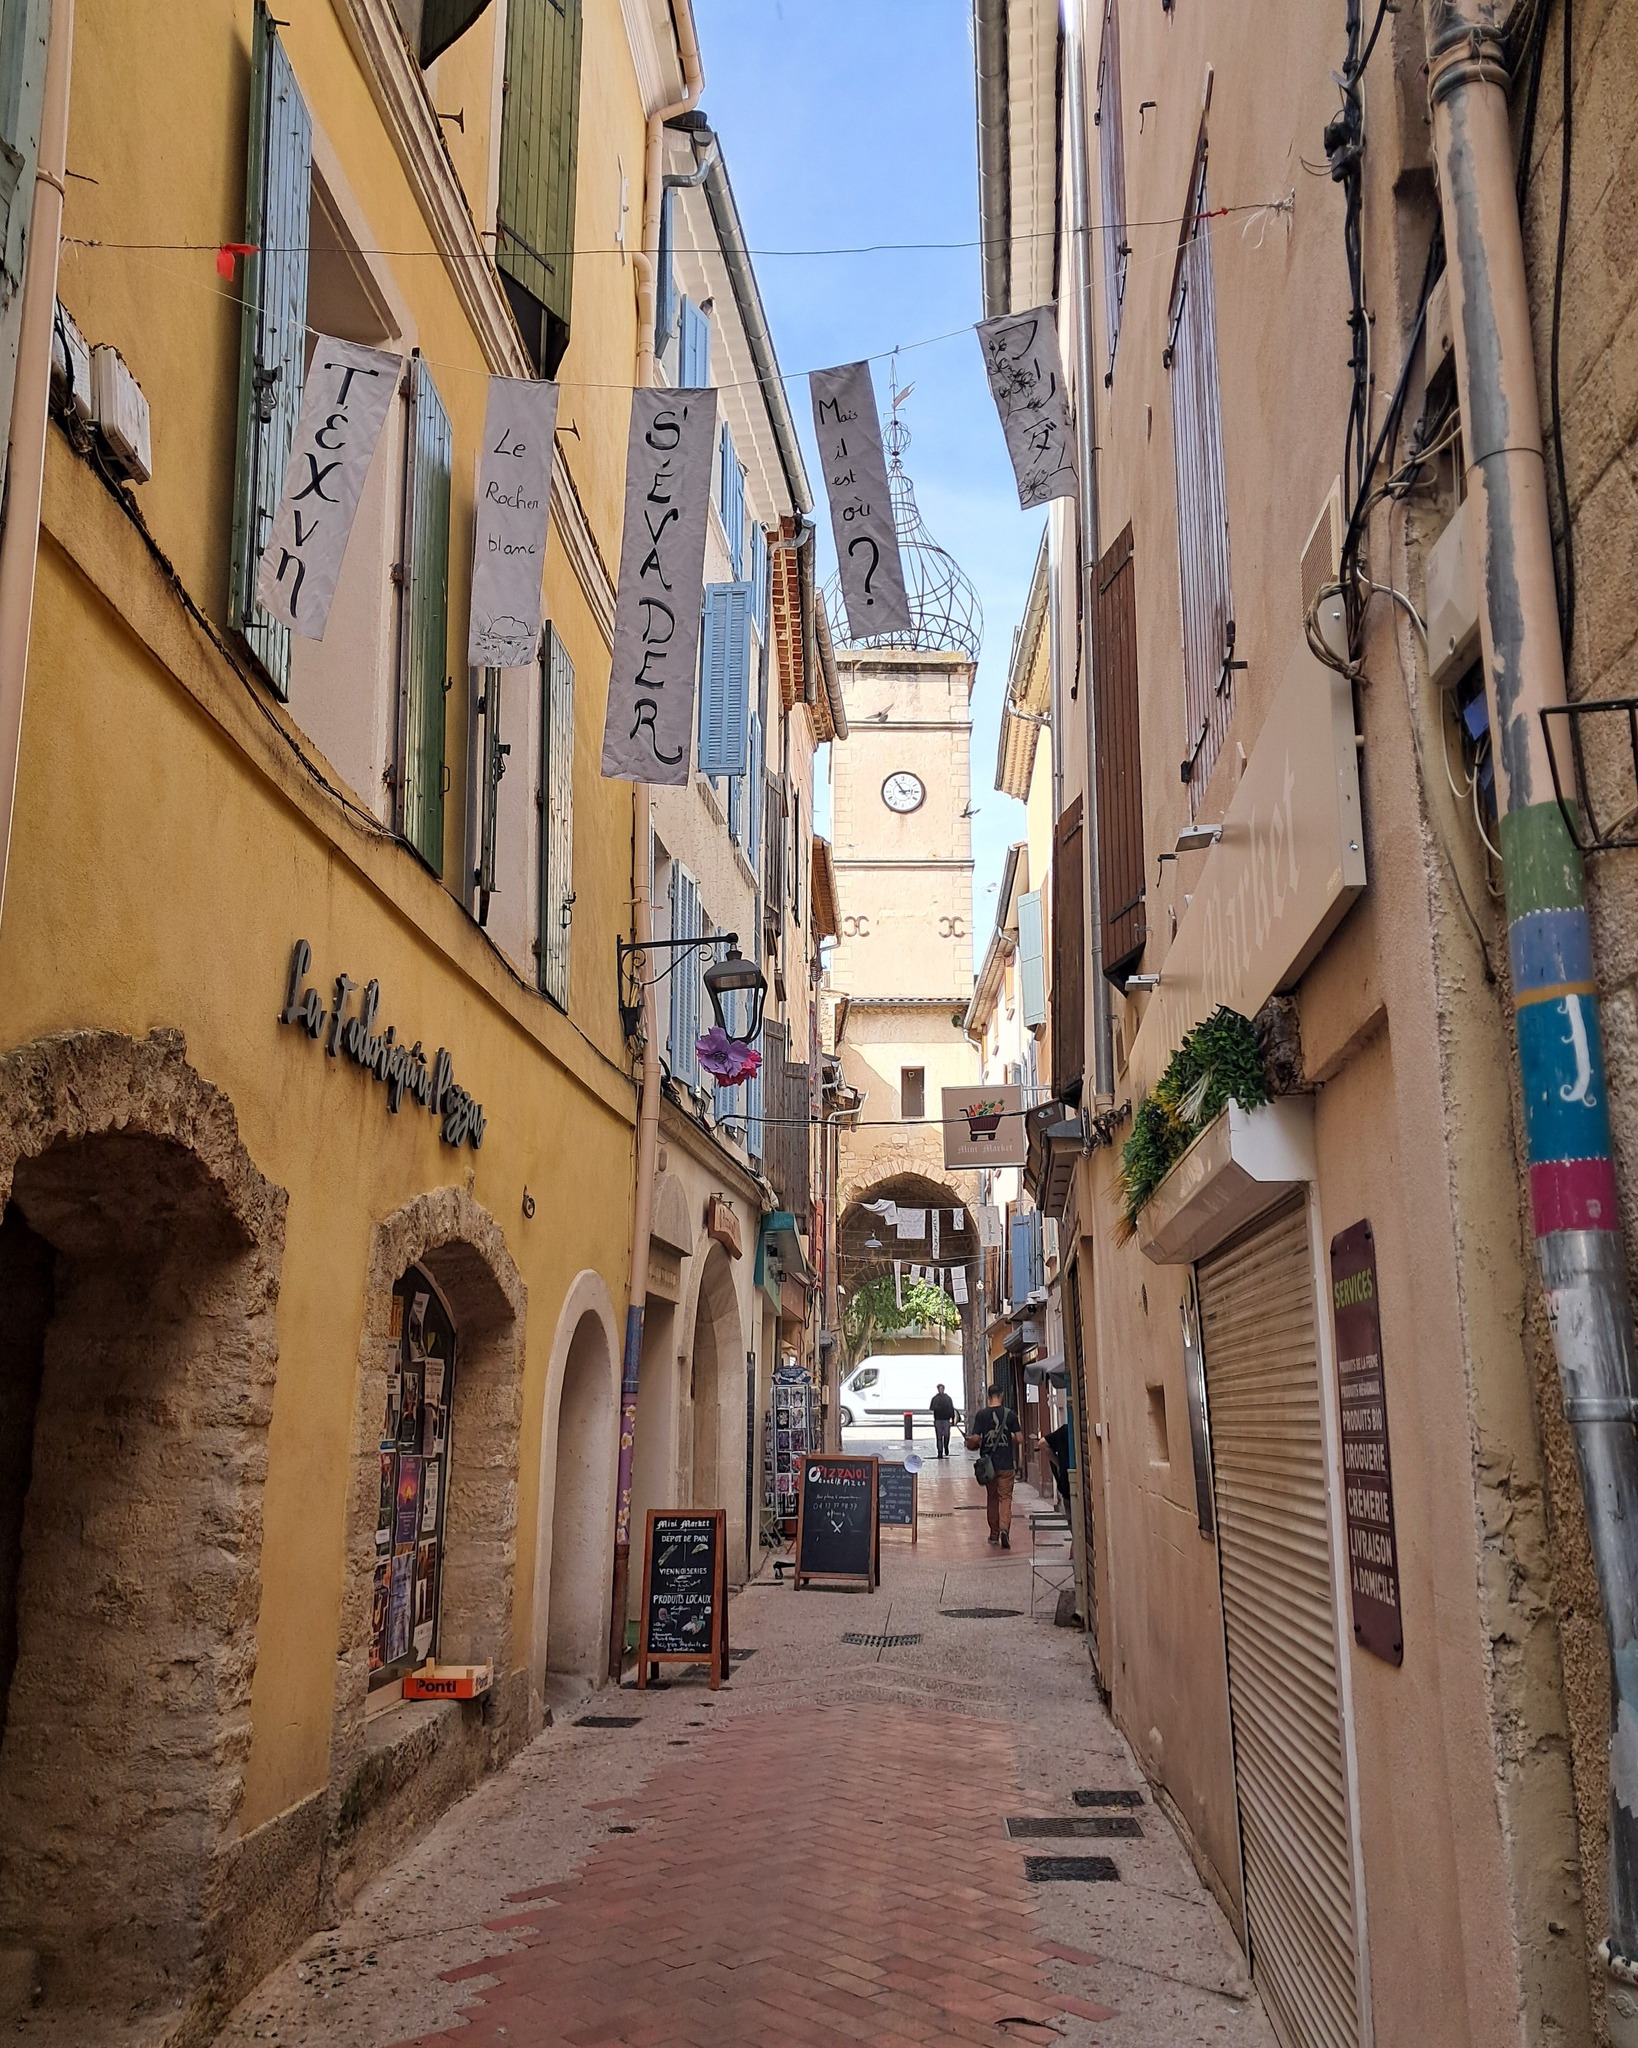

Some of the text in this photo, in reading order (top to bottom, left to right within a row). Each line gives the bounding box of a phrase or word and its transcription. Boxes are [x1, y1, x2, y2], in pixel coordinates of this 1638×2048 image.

[818, 397, 859, 424] Mais
[494, 428, 527, 459] Le
[834, 437, 848, 461] il
[831, 471, 857, 487] est
[485, 480, 541, 510] Rocher
[842, 496, 871, 522] où
[488, 533, 536, 555] blanc
[848, 536, 879, 606] ?
[1201, 746, 1301, 1012] Market
[280, 938, 327, 1040] La
[957, 1143, 1014, 1155] Mini Market
[1335, 1268, 1373, 1310] SERVICES
[1342, 1408, 1383, 1432] PRODUITS BIO
[1344, 1443, 1386, 1473] DROGUERIE
[656, 1519, 710, 1530] Mini Market
[683, 1535, 693, 1543] DE
[693, 1535, 709, 1543] PAIN
[1350, 1527, 1392, 1567] LIVRAISON
[659, 1567, 708, 1576] VIENNOISERIES
[653, 1594, 712, 1605] PRODUITS LOCAUX
[1359, 1566, 1396, 1608] DOMICILE
